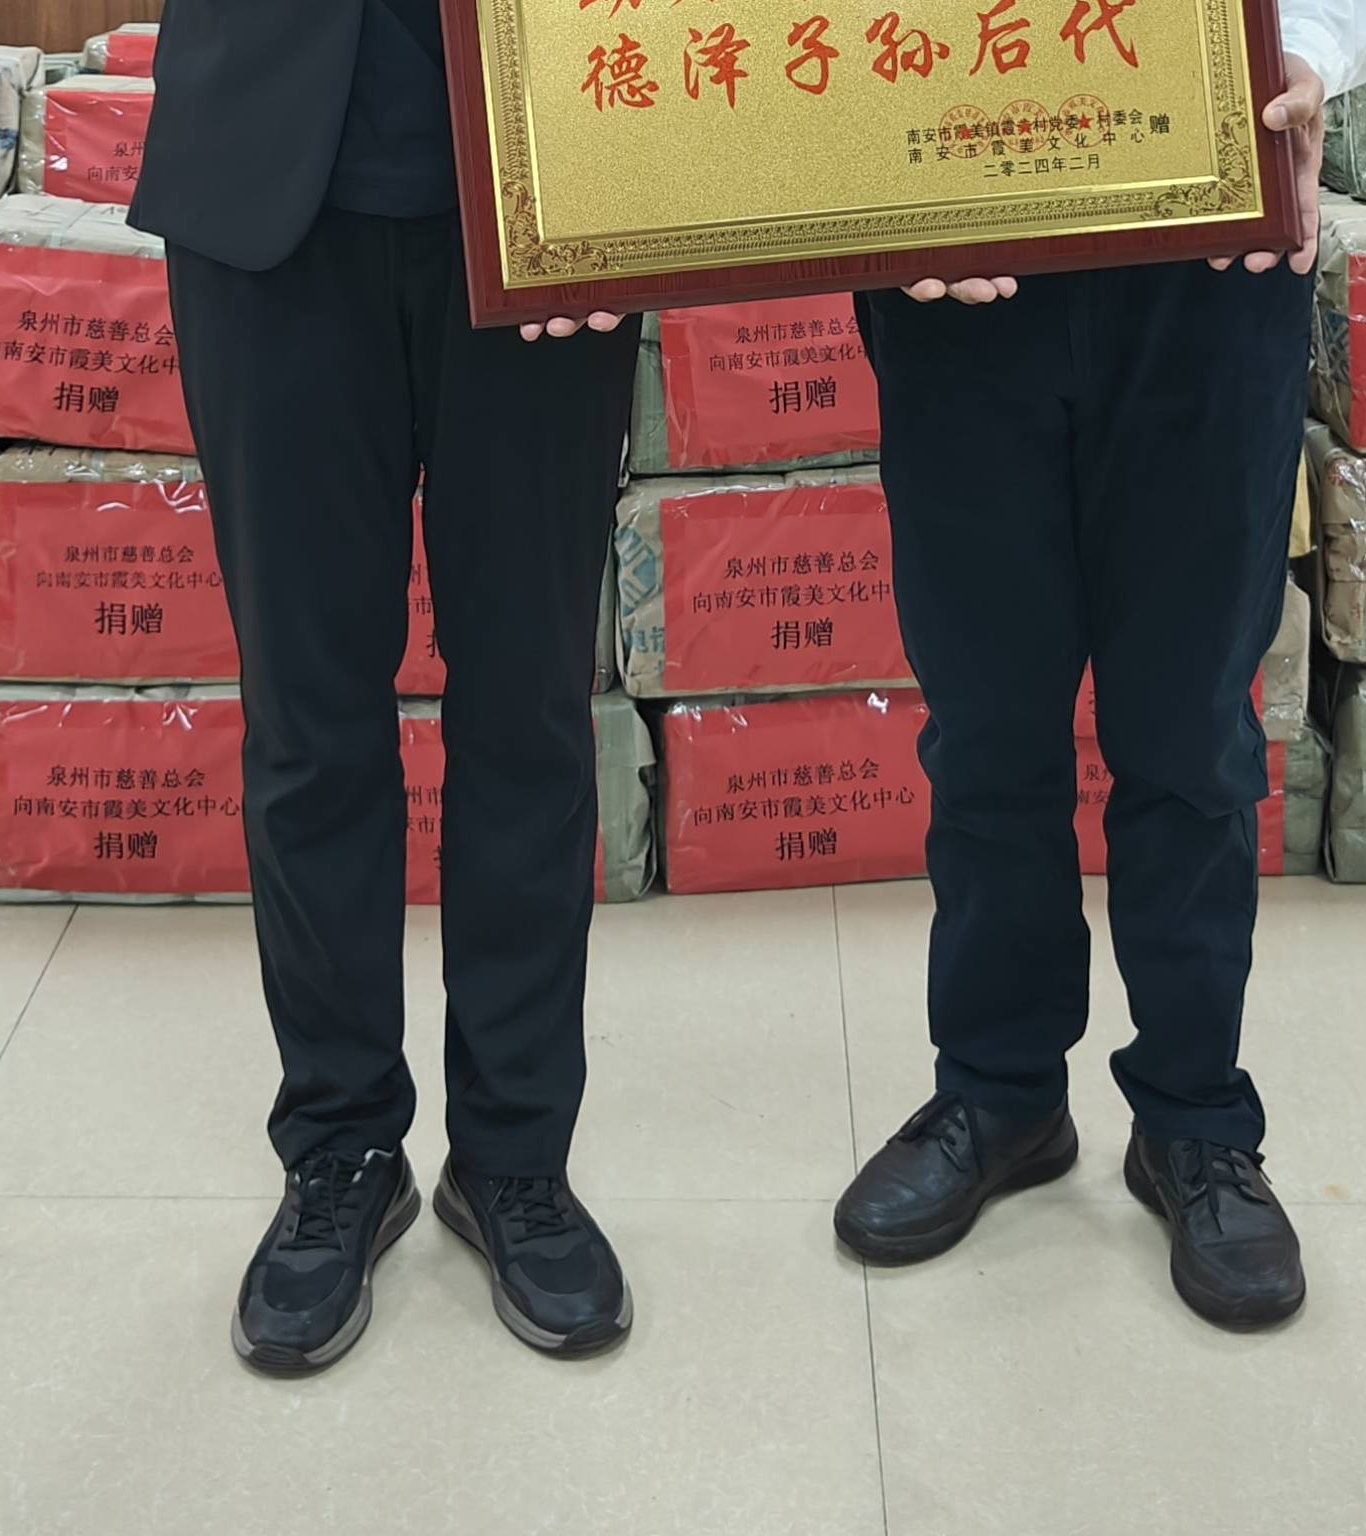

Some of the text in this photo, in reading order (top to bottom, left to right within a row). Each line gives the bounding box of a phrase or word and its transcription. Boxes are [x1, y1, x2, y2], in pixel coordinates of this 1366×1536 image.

[983, 153, 1101, 178] 二零二四年二月
[17, 309, 175, 346] 泉州市慈善总会
[53, 381, 120, 414] 捐赠
[769, 375, 837, 414] 捐赠
[64, 544, 195, 563] 泉州市慈善总会
[725, 549, 879, 579] 泉州市慈善总会
[35, 568, 222, 590] 向南安市霞美文化中心
[94, 601, 164, 635] 捐赠
[771, 619, 834, 650] 捐赠
[46, 764, 205, 789] 泉州市慈善总会
[727, 757, 879, 794] 泉州市慈善总会
[12, 794, 241, 820] 向南安市霞美文化中心
[694, 786, 915, 827] 向南安市霞美文化中心
[93, 830, 158, 859] 捐赠
[775, 828, 838, 860] 捐赠
